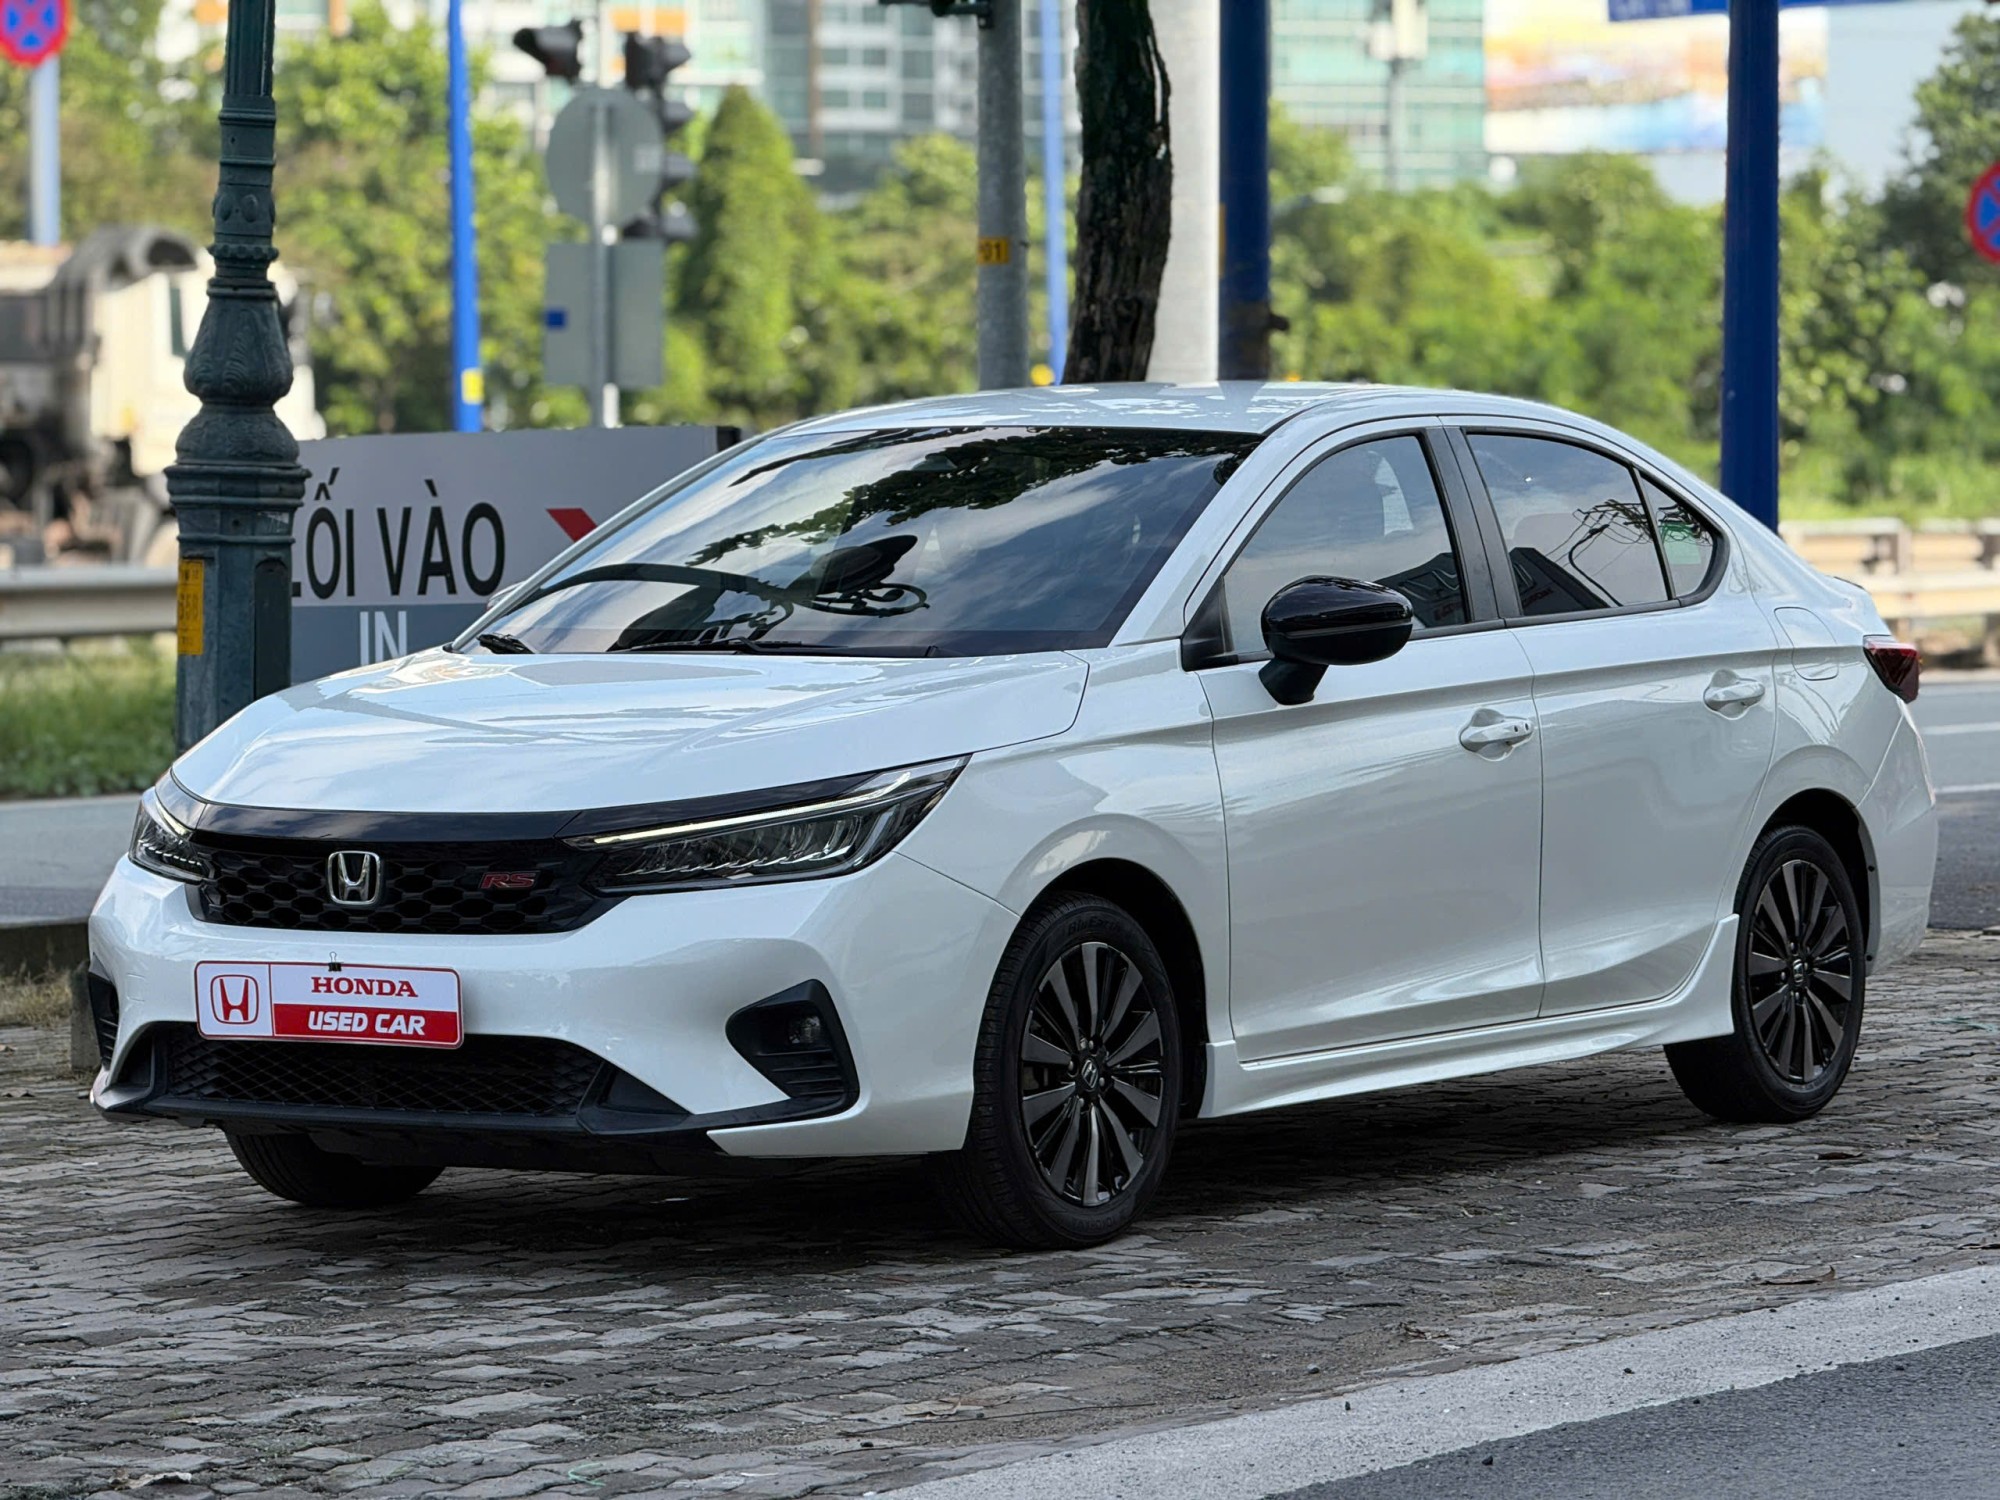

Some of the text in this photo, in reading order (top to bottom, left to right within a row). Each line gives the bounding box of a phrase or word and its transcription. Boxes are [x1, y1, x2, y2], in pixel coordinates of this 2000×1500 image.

[292, 467, 505, 599] ỐI VÀO
[360, 611, 407, 667] IN
[480, 870, 538, 889] RS
[310, 976, 419, 998] HONDA
[307, 1010, 426, 1036] USED CAR
